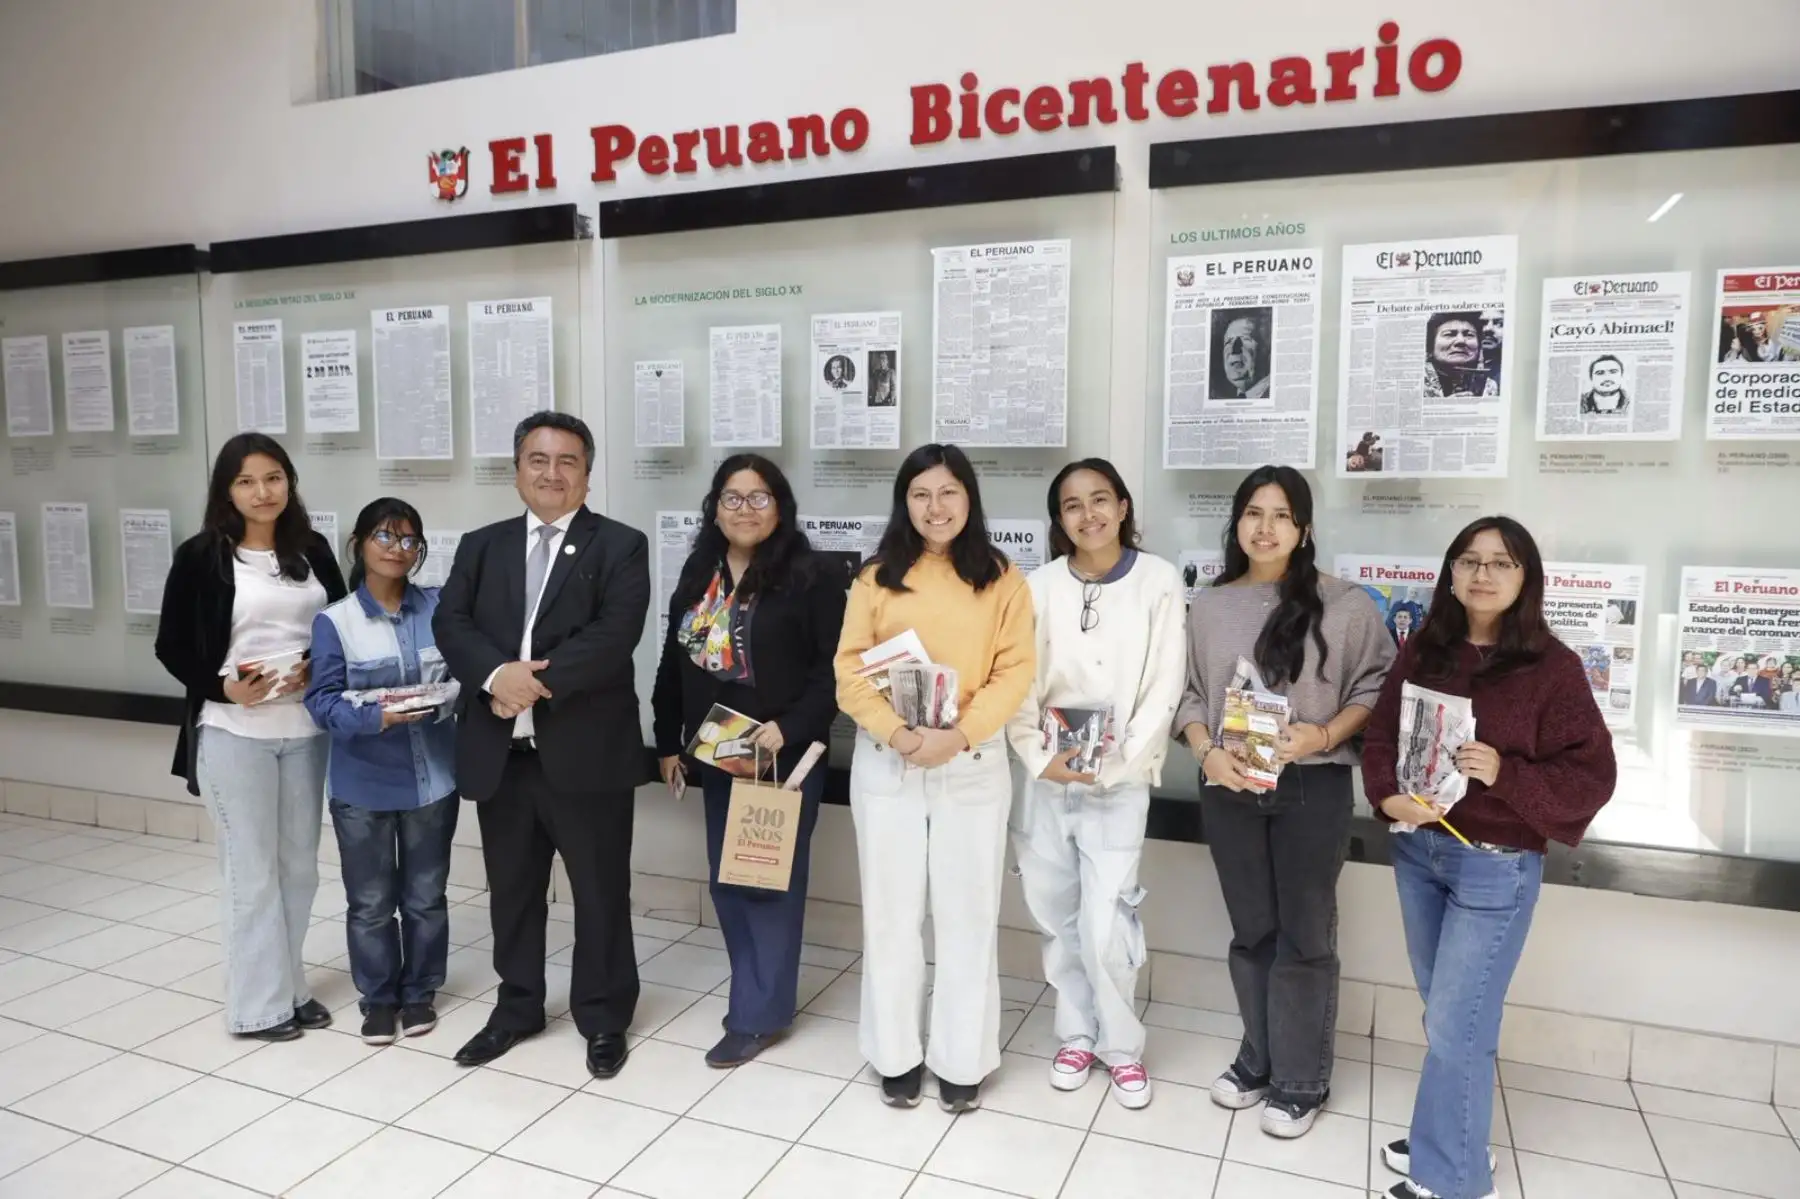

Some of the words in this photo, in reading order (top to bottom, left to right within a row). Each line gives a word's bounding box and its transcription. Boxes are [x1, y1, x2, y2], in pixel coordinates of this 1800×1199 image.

[488, 134, 557, 194] El
[590, 107, 869, 183] Peruano
[910, 21, 1463, 145] Bicentenario
[1170, 231, 1197, 244] LOS
[1201, 226, 1261, 242] ULTIMOS
[1265, 221, 1306, 237] AÑOS
[970, 249, 982, 258] EL
[985, 245, 1035, 256] PERUANO
[1206, 262, 1227, 276] EL
[1232, 256, 1313, 274] PERUANO
[1376, 251, 1394, 270] El
[1413, 249, 1483, 271] Peruano
[1573, 281, 1588, 296] El
[1602, 279, 1659, 297] Peruano
[1754, 275, 1770, 288] El
[635, 296, 647, 306] LA
[650, 289, 730, 304] MODERNIZACION
[732, 287, 753, 299] DEL
[755, 286, 787, 298] SIGLO
[789, 284, 803, 295] XX
[234, 300, 243, 309] LA
[484, 305, 492, 315] EL
[1376, 302, 1413, 313] Debate
[1414, 301, 1450, 312] abierto
[1451, 301, 1479, 310] sobre
[1481, 301, 1504, 310] coca
[386, 311, 395, 322] EL
[1550, 323, 1596, 339] ¡Cayó
[1599, 320, 1674, 335] Abimael!
[1715, 386, 1738, 399] de
[1714, 401, 1742, 414] del
[684, 516, 694, 525] EL
[806, 521, 817, 530] EL
[819, 520, 862, 530] PERUANO
[1359, 566, 1373, 578] El
[1375, 567, 1436, 581] Peruano
[1551, 576, 1613, 589] Peruano
[1714, 581, 1729, 593] El
[1733, 581, 1798, 596] Peruano
[1557, 600, 1604, 610] presenta
[1688, 603, 1730, 614] Estado
[1731, 604, 1747, 614] de
[1585, 610, 1598, 618] de
[1550, 618, 1588, 628] política
[1692, 614, 1744, 625] nacional
[1746, 618, 1775, 628] para
[1682, 625, 1727, 635] avance
[1727, 626, 1747, 636] del
[740, 804, 786, 829] 200
